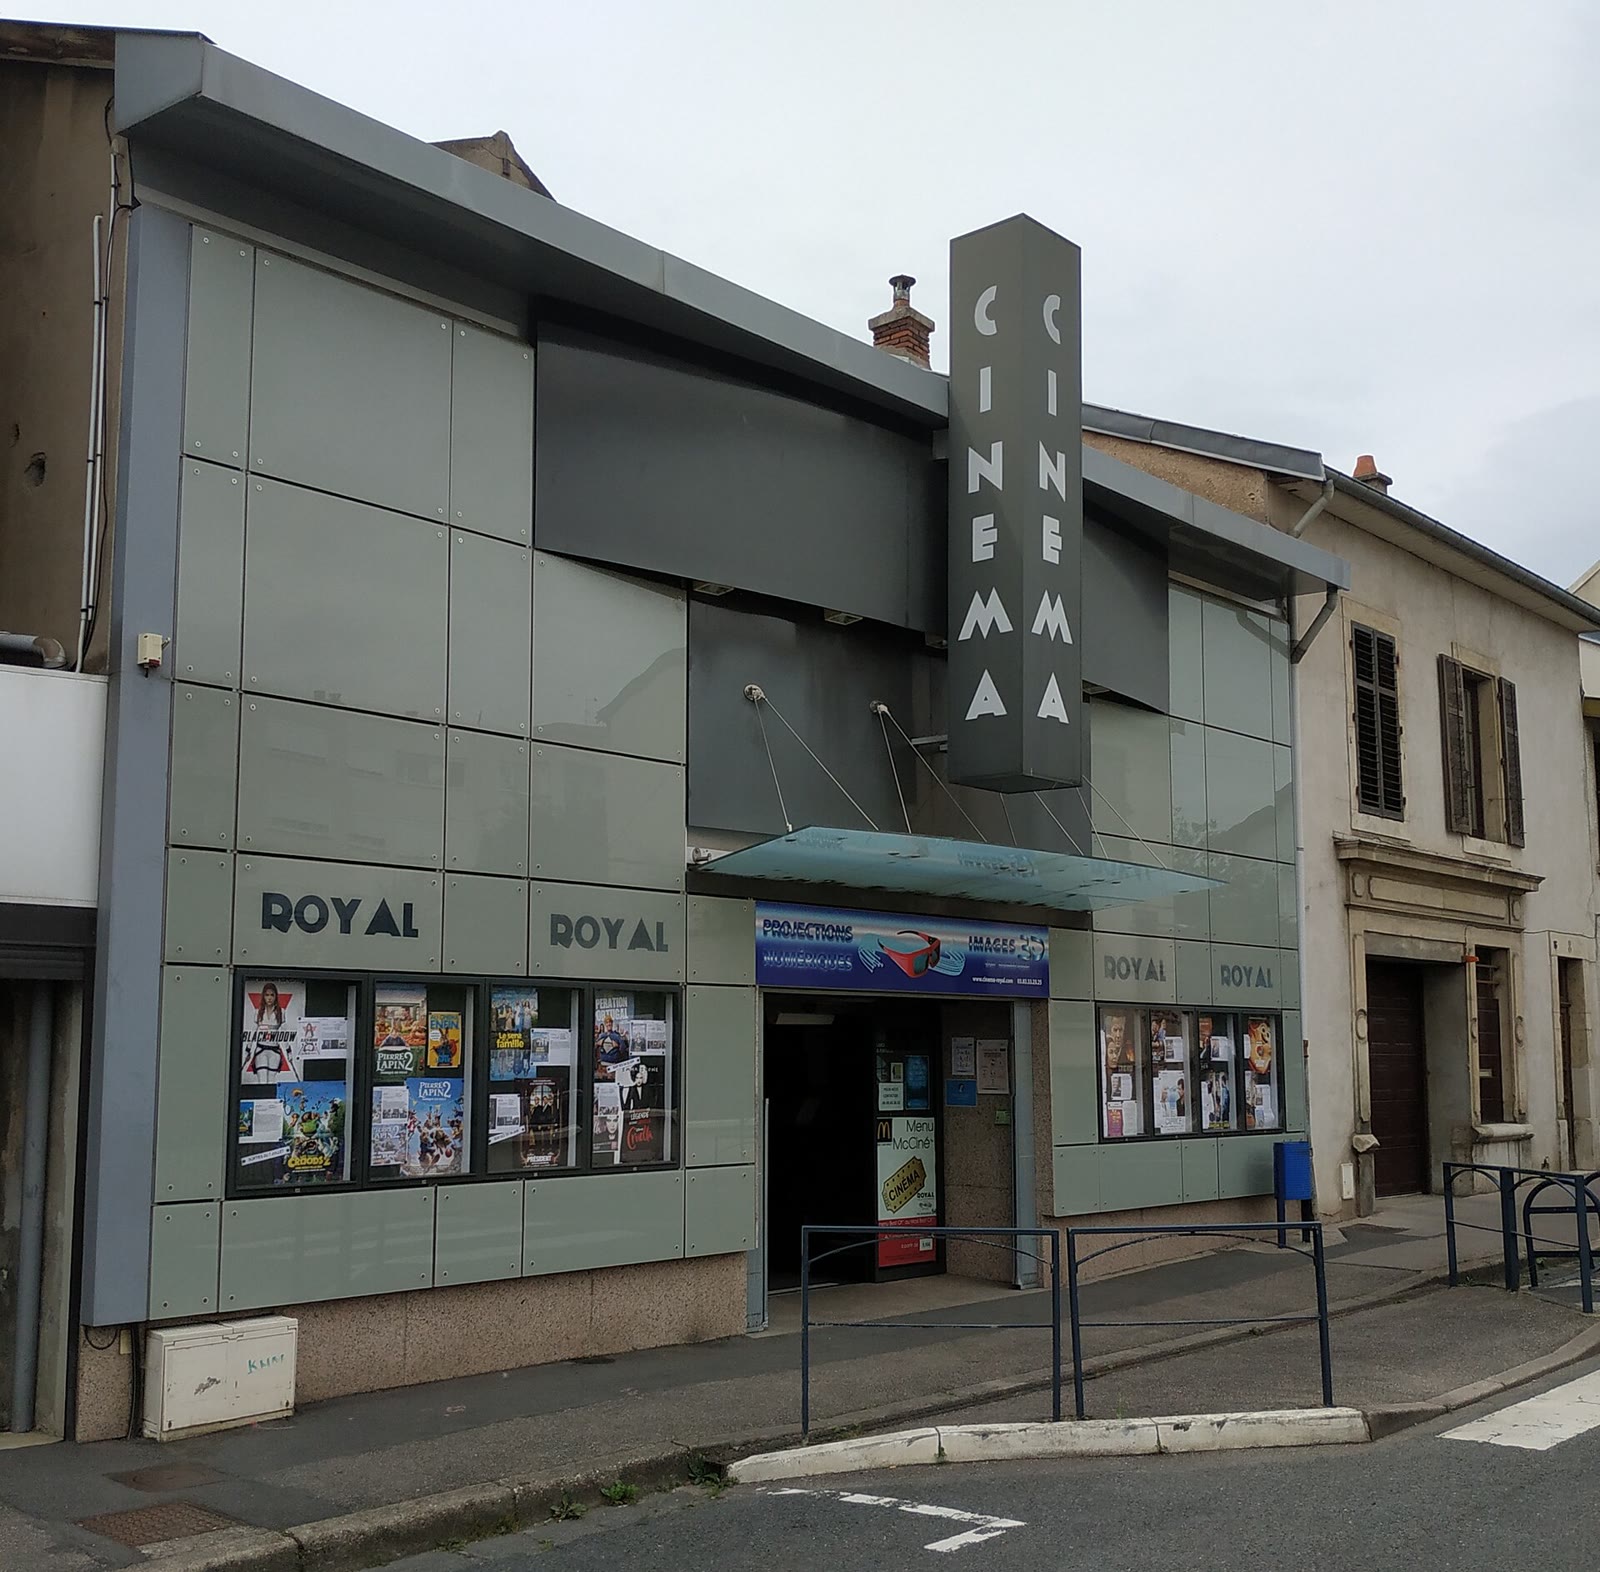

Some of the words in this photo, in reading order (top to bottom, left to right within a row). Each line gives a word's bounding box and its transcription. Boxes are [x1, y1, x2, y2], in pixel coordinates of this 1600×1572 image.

[957, 284, 1014, 722] CINEMA
[1031, 294, 1074, 725] CINEMA
[261, 892, 419, 939] ROYAL
[550, 913, 669, 953] ROYAL
[763, 919, 854, 943] PROJECTIONS
[968, 935, 1017, 954] IMAGES
[762, 947, 854, 972] NUMÉRIQUES
[1103, 955, 1167, 982] ROYAL
[1220, 964, 1274, 989] ROYAL
[242, 1031, 267, 1043] BLACK
[268, 1031, 298, 1043] WIDOW
[376, 1061, 406, 1072] LAPIN
[377, 1053, 405, 1061] PIERRE
[418, 1088, 444, 1098] LAPIN
[419, 1081, 443, 1089] PIERRE
[906, 1119, 934, 1133] Menu
[287, 1155, 324, 1168] CROODS
[888, 1169, 921, 1202] CINÉMA
